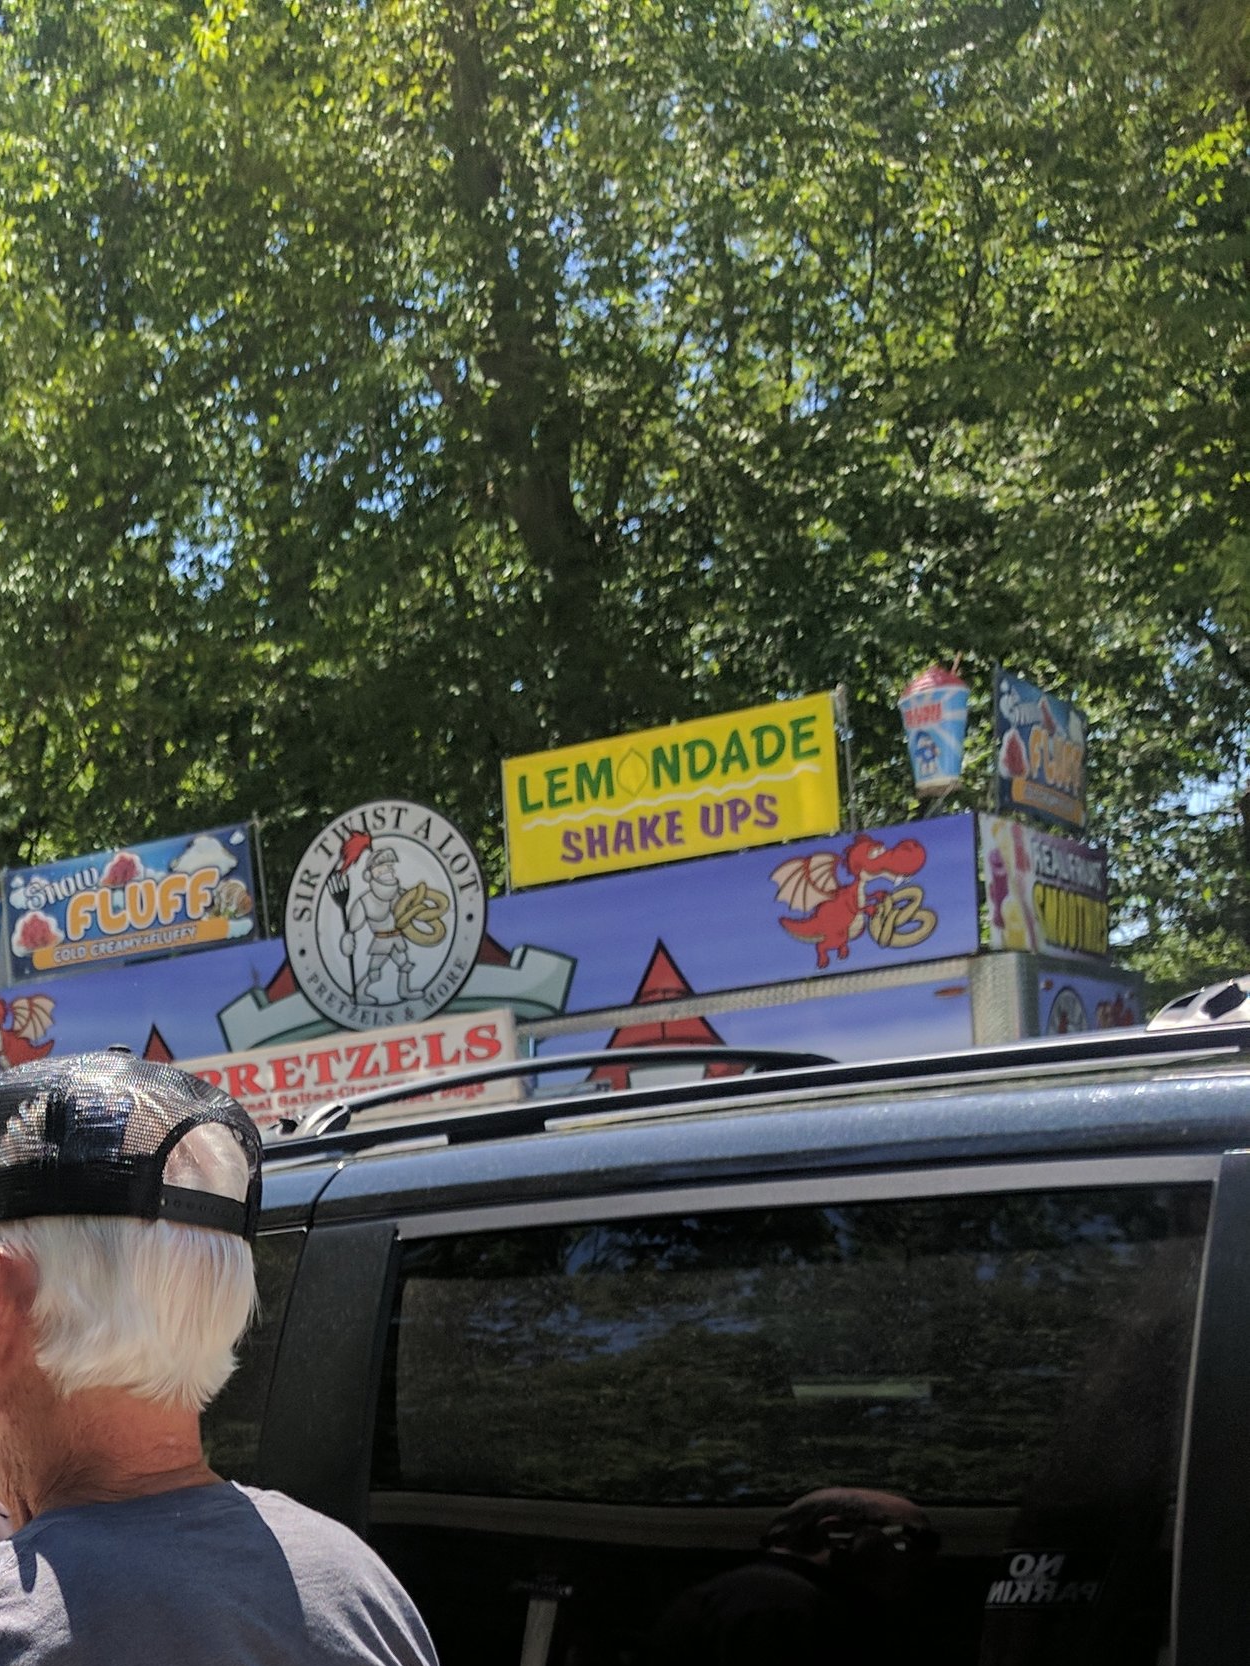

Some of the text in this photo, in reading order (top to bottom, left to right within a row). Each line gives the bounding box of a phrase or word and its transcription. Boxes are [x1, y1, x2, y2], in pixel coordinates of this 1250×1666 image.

[561, 794, 779, 863] SHAKE UPS
[25, 866, 100, 910] Snow
[292, 806, 480, 923] SIR TWIST A LOT
[66, 867, 221, 941] FLUFF
[53, 944, 87, 964] COLD
[307, 973, 394, 1025] PRETZELS
[423, 960, 468, 1009] MORE
